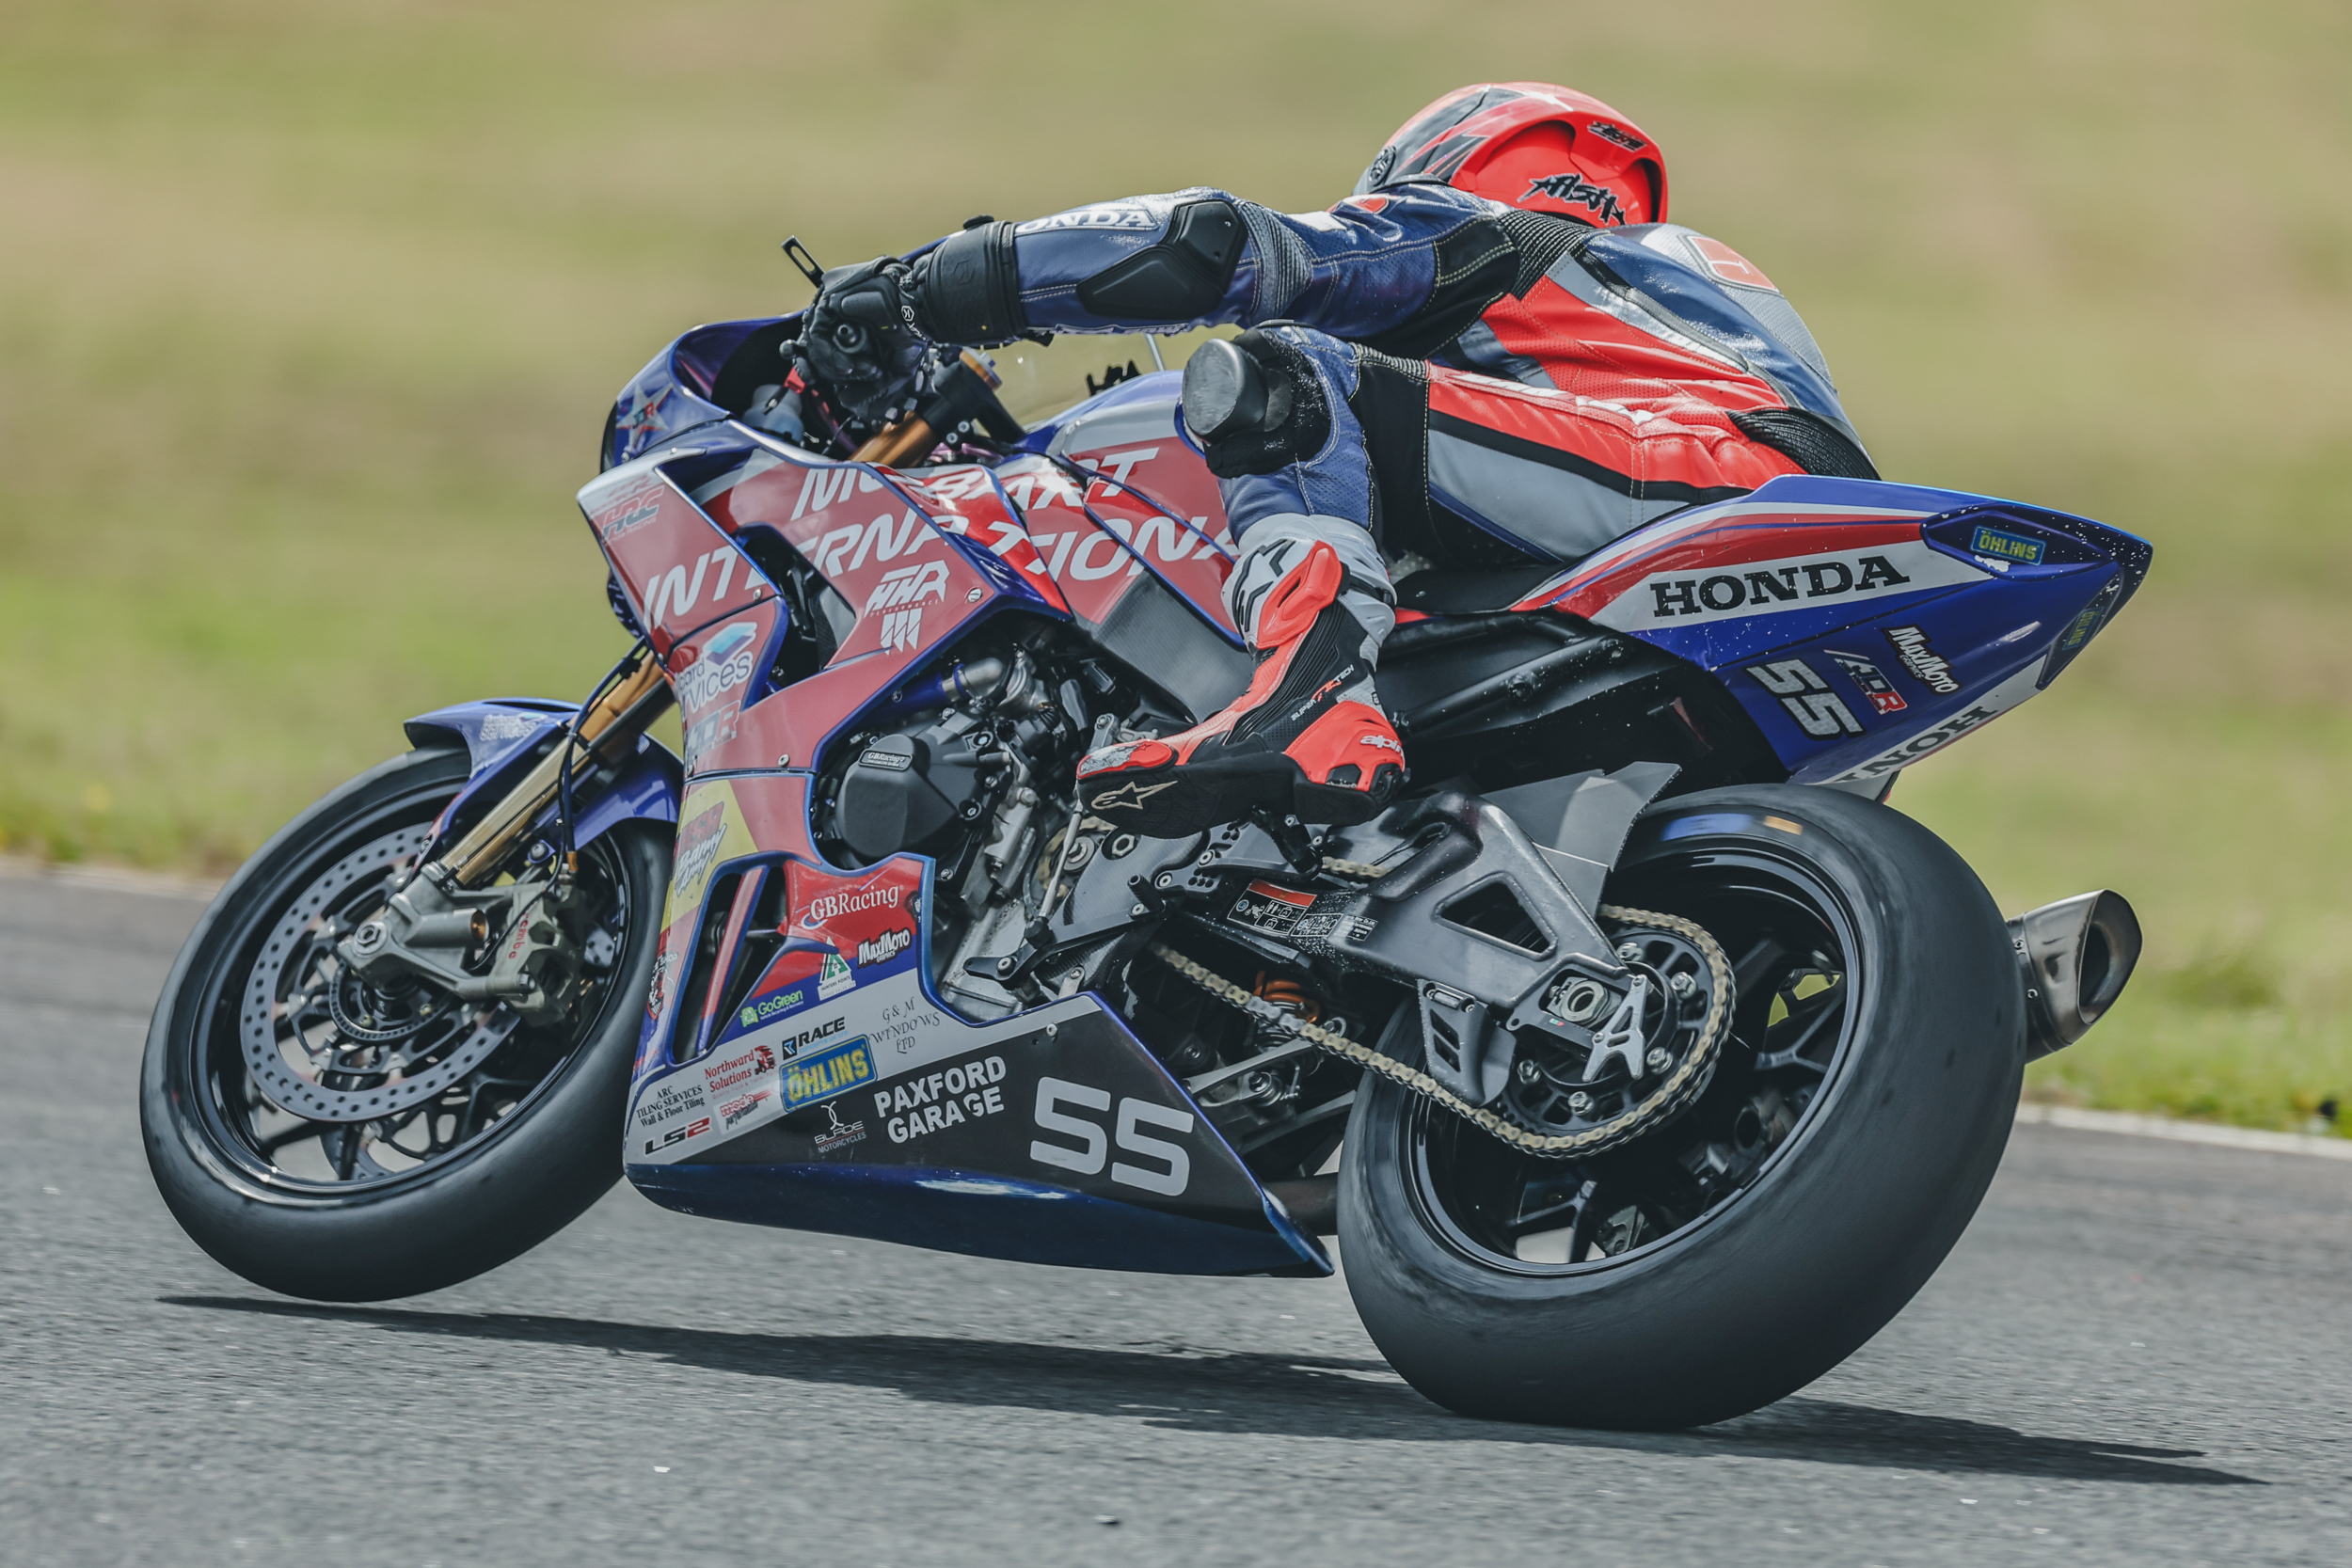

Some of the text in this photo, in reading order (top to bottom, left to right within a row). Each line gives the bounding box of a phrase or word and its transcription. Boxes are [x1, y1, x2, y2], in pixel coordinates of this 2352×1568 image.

[1015, 210, 1155, 233] ONDA
[1979, 530, 2037, 561] ÖHLINS
[644, 515, 1242, 633] INTRNATIONA
[1650, 556, 1911, 618] HONDA
[870, 599, 938, 617] PERFORMANCE
[682, 656, 751, 715] vices
[1747, 658, 1864, 736] 55
[1835, 706, 1998, 783] HON
[810, 885, 898, 920] GBRacing
[509, 912, 530, 958] rembo
[758, 990, 803, 1015] GoGreen
[882, 996, 914, 1024] G & M
[799, 1017, 845, 1047] RACE
[868, 1011, 940, 1043] WINDOWS
[897, 1036, 915, 1053] LTD
[705, 1050, 755, 1080] Northward
[787, 1049, 869, 1101] ÖHLINS
[658, 1085, 674, 1100] ARC
[709, 1069, 752, 1093] Solutions
[874, 1055, 1007, 1117] PAXFORD
[637, 1085, 703, 1118] TILING SERVICES
[640, 1097, 706, 1128] Wall & Floor Tiling
[720, 1094, 755, 1117] mode
[887, 1086, 1005, 1144] GARAGE
[644, 1117, 710, 1155] LS2
[815, 1121, 864, 1144] BLADE
[818, 1132, 866, 1153] MOTORCYCLES
[1030, 1076, 1195, 1196] 55
